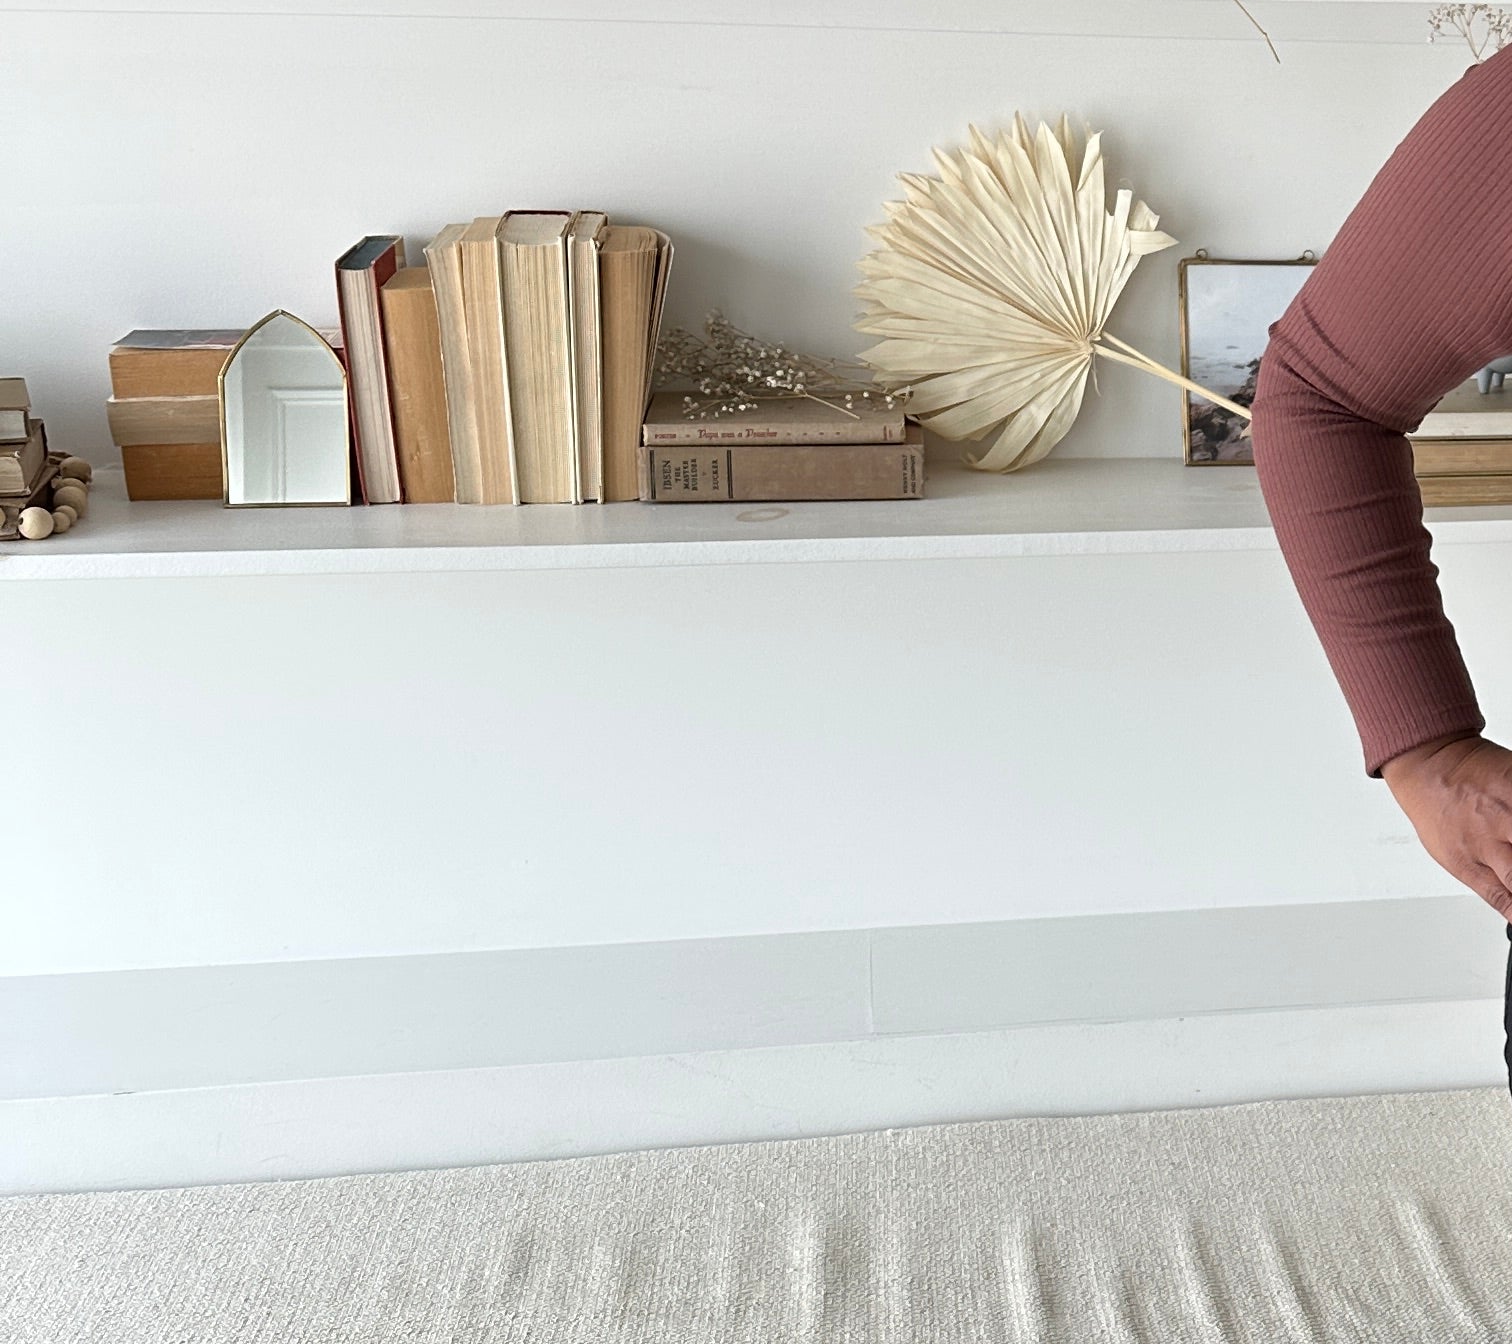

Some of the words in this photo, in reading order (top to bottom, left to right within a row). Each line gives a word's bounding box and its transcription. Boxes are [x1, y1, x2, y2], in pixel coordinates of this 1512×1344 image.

[661, 459, 673, 491] IBSEN
[674, 466, 682, 483] THE
[682, 459, 691, 490] MASTER
[691, 458, 699, 492] BUILDER
